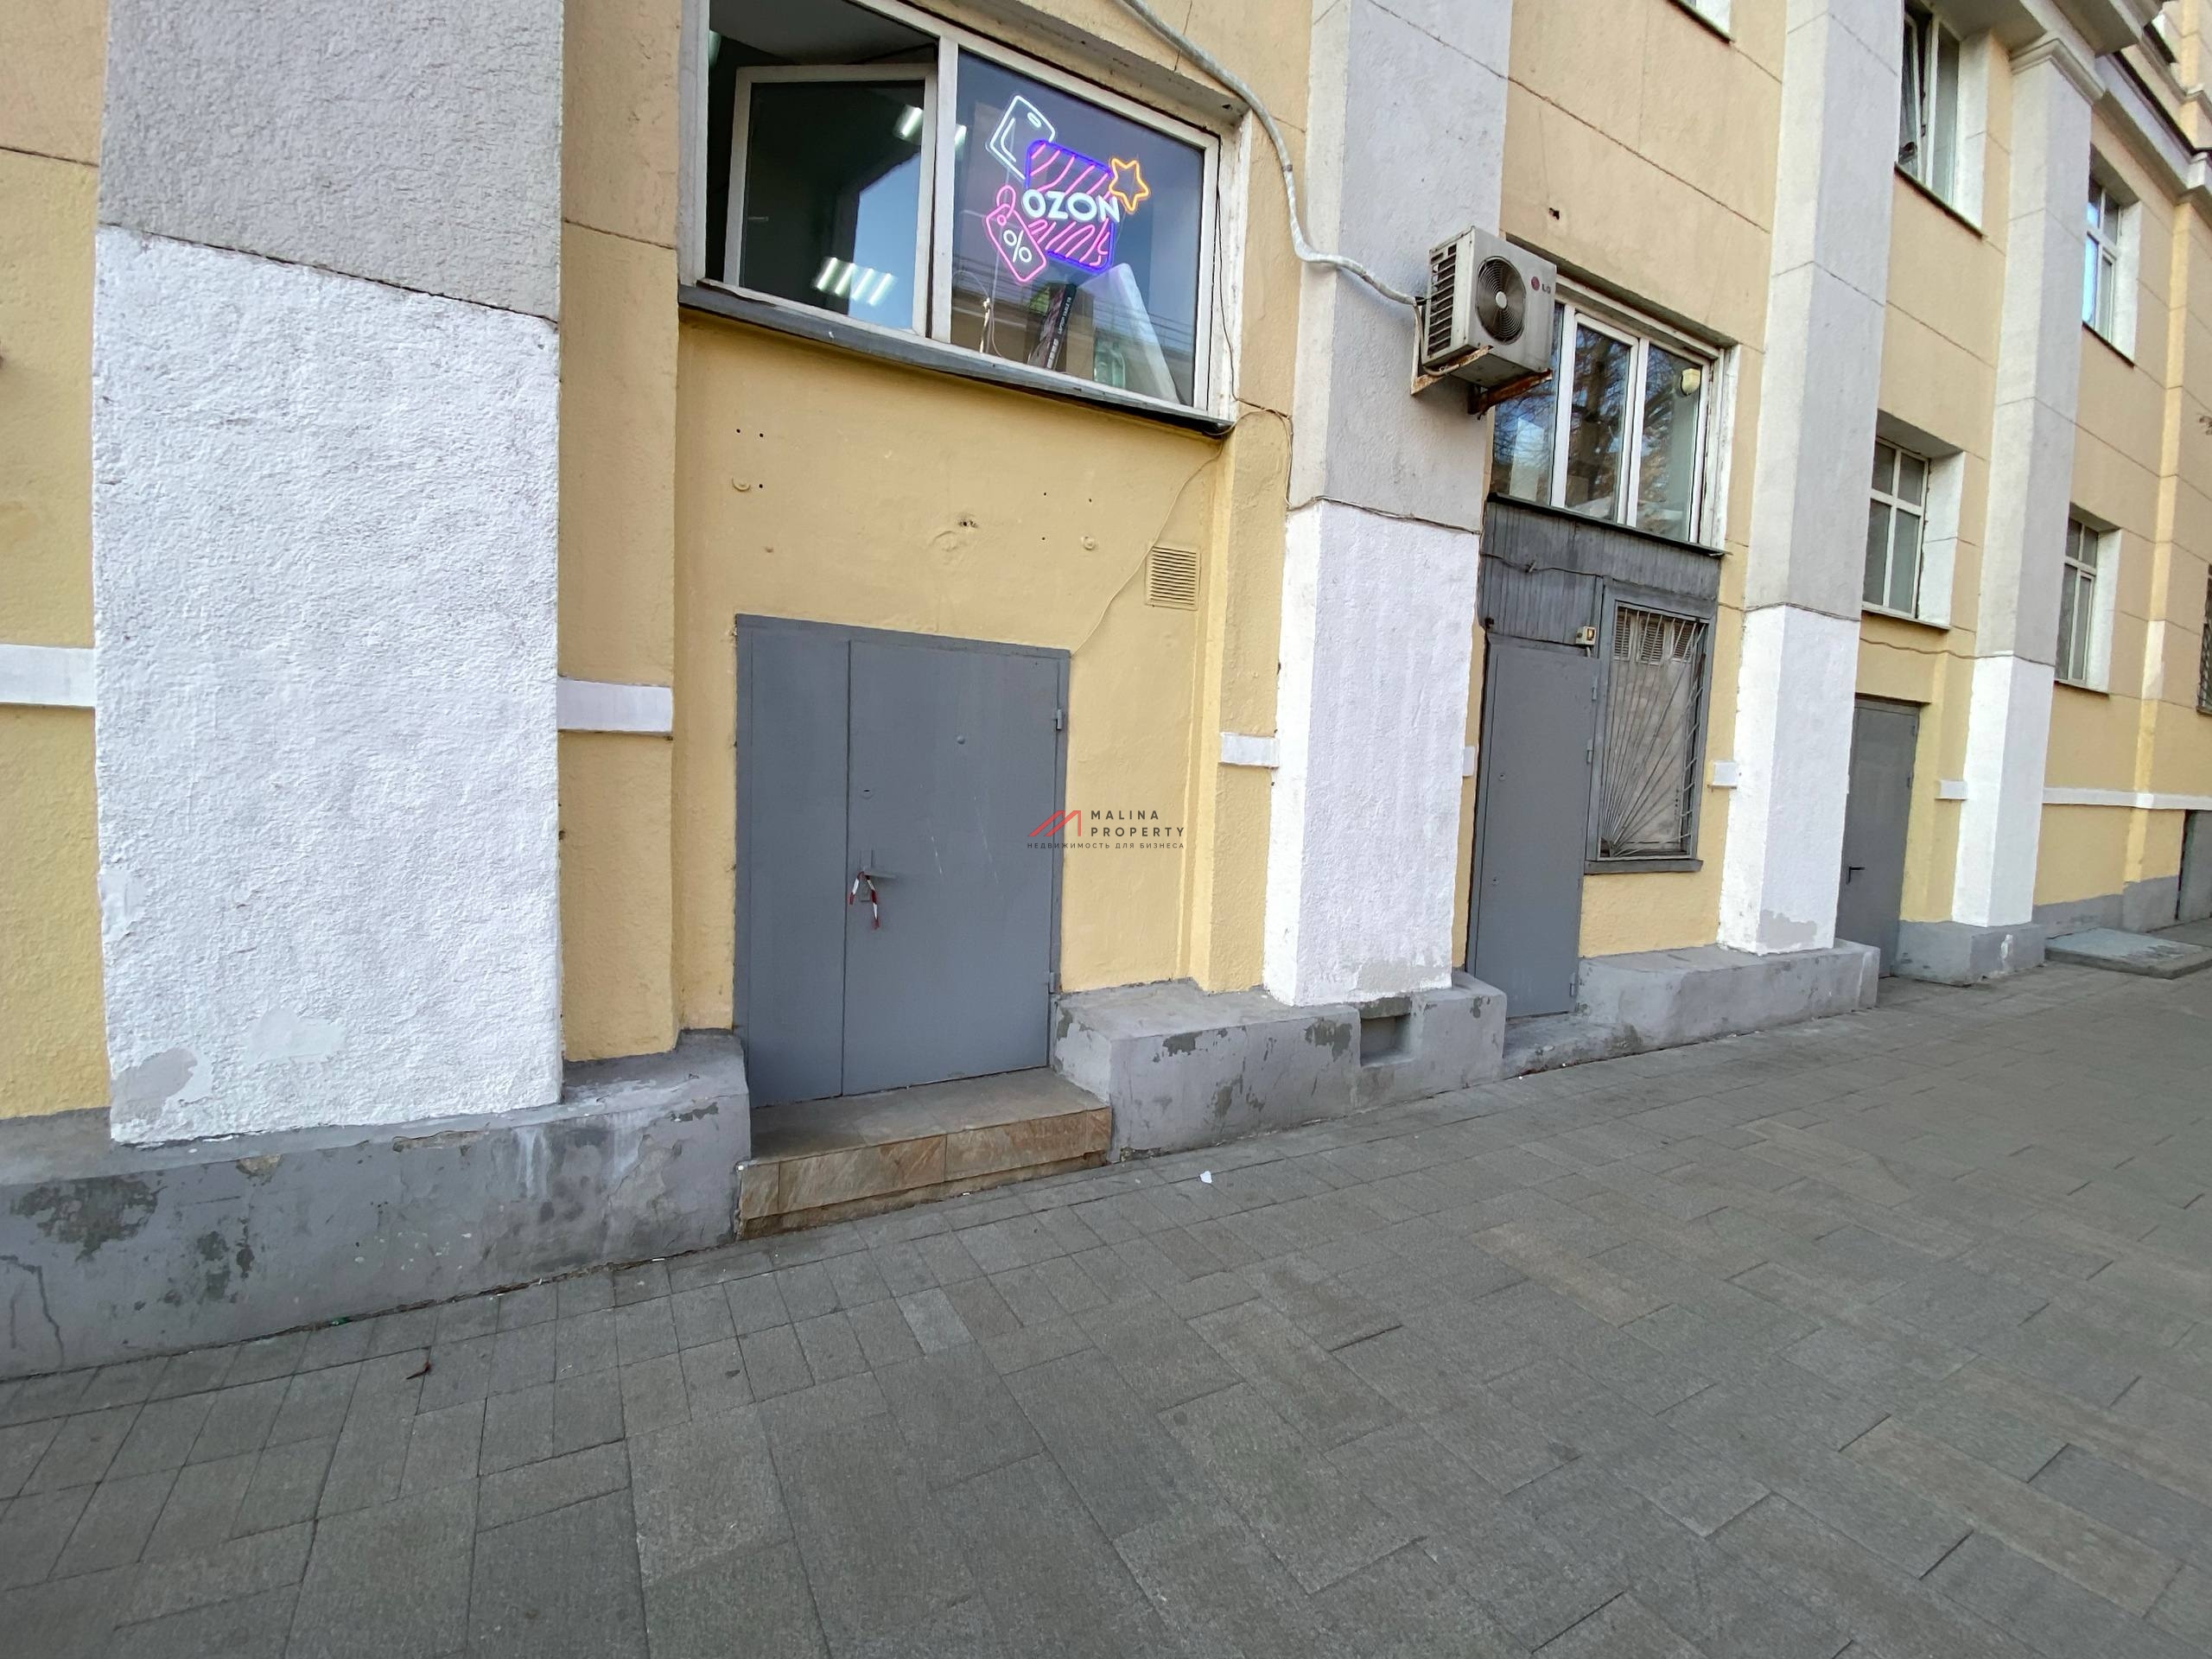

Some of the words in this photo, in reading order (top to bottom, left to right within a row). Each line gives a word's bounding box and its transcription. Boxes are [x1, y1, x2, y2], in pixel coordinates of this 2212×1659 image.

[1022, 188, 1121, 223] OZON
[1002, 229, 1033, 263] %
[1541, 283, 1551, 294] LG
